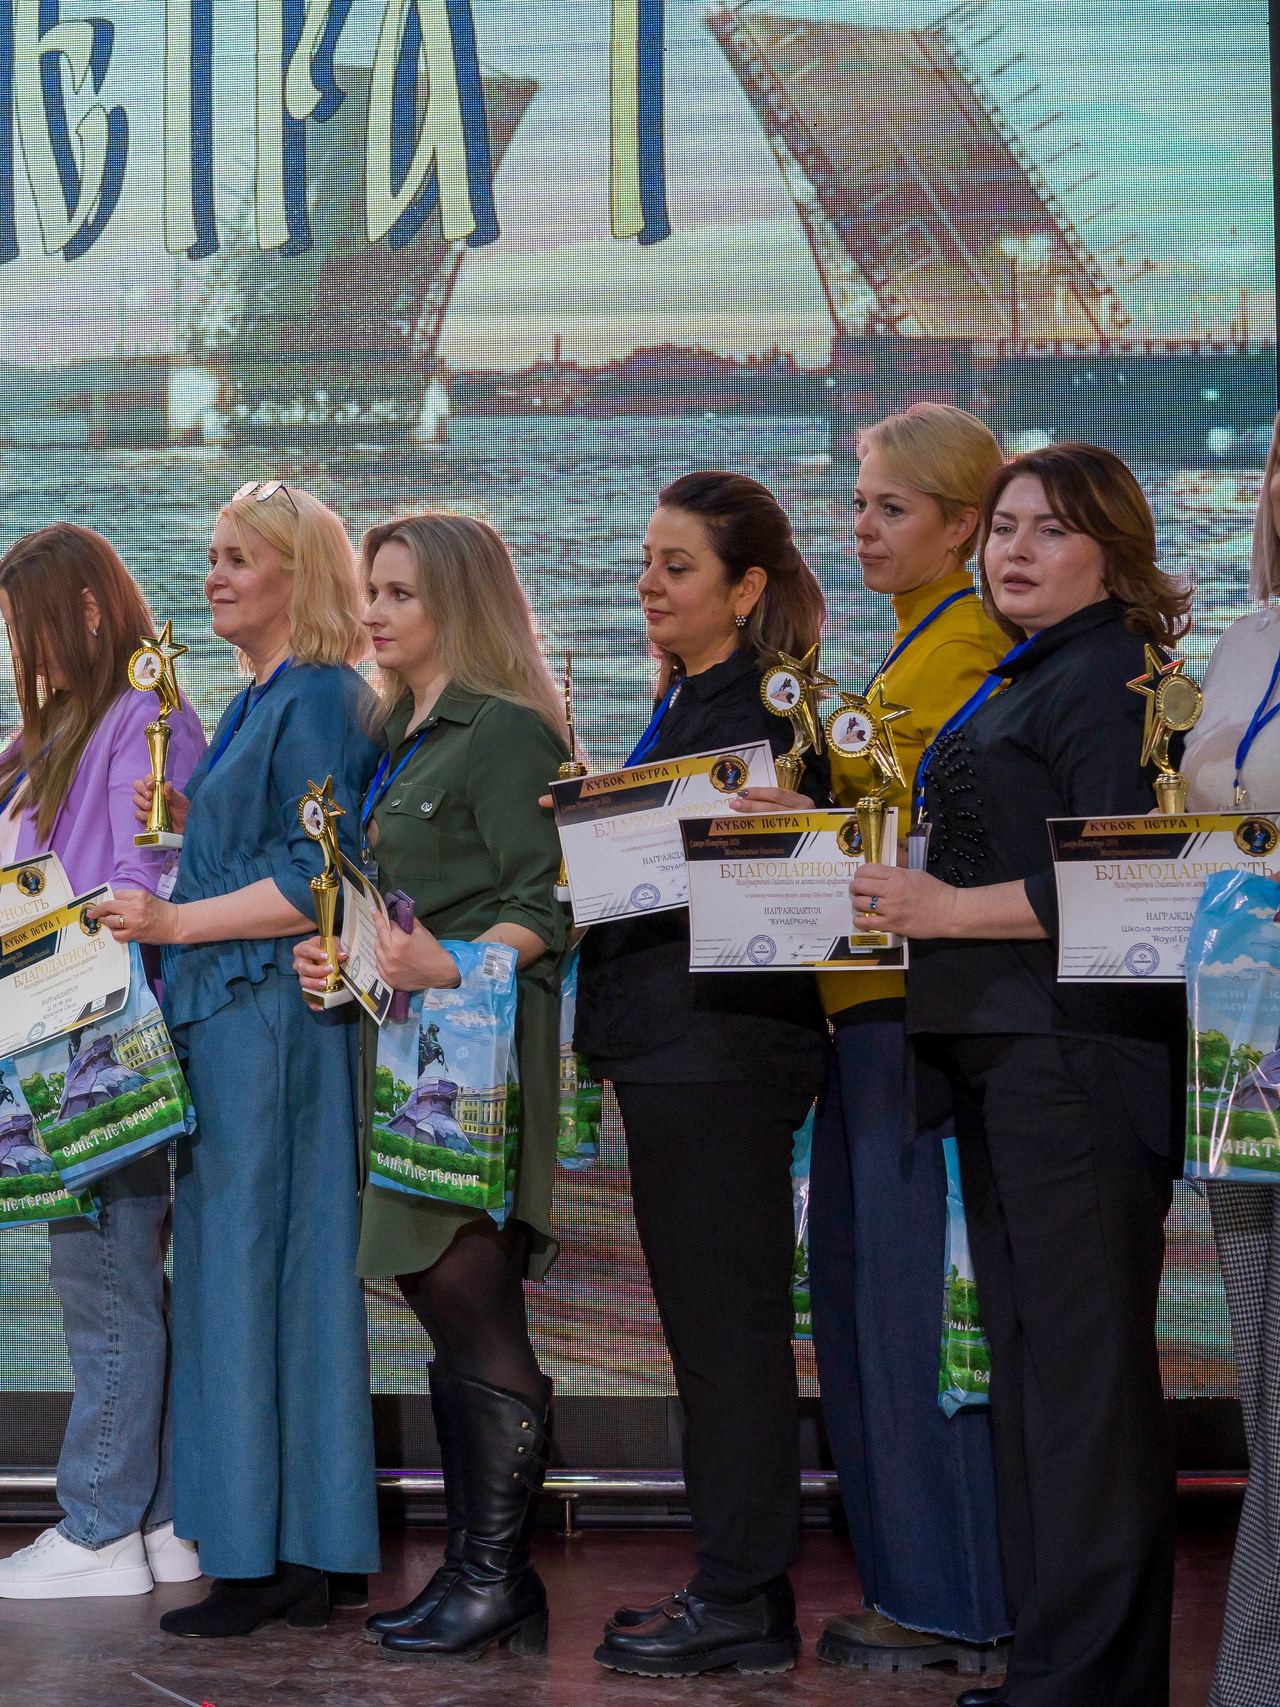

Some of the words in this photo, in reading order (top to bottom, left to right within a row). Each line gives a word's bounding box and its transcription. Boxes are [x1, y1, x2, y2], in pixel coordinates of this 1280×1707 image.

[586, 775, 625, 791] КУБОК
[632, 766, 670, 782] ПЕТРА
[593, 797, 738, 839] БЛАГОДАРНОС
[716, 818, 754, 831] КУБОК
[762, 816, 799, 829] ПЕТРА
[1090, 819, 1136, 832] КУБОК
[1144, 818, 1188, 830] ПЕТРА
[642, 851, 685, 865] НАГРАЖДА
[764, 906, 821, 915] НАГРАЖДАЕТСЯ
[1146, 912, 1196, 921] НАГРАЖДА
[4, 933, 29, 949] КУБОК
[31, 923, 55, 937] ПЕТРА
[1122, 925, 1151, 933] Школа
[1153, 926, 1191, 935] иностра
[13, 937, 106, 988] БЛАГОДАРНОСТЬ
[62, 1096, 167, 1158] САНКТ-ПЕТЕРБУРГ
